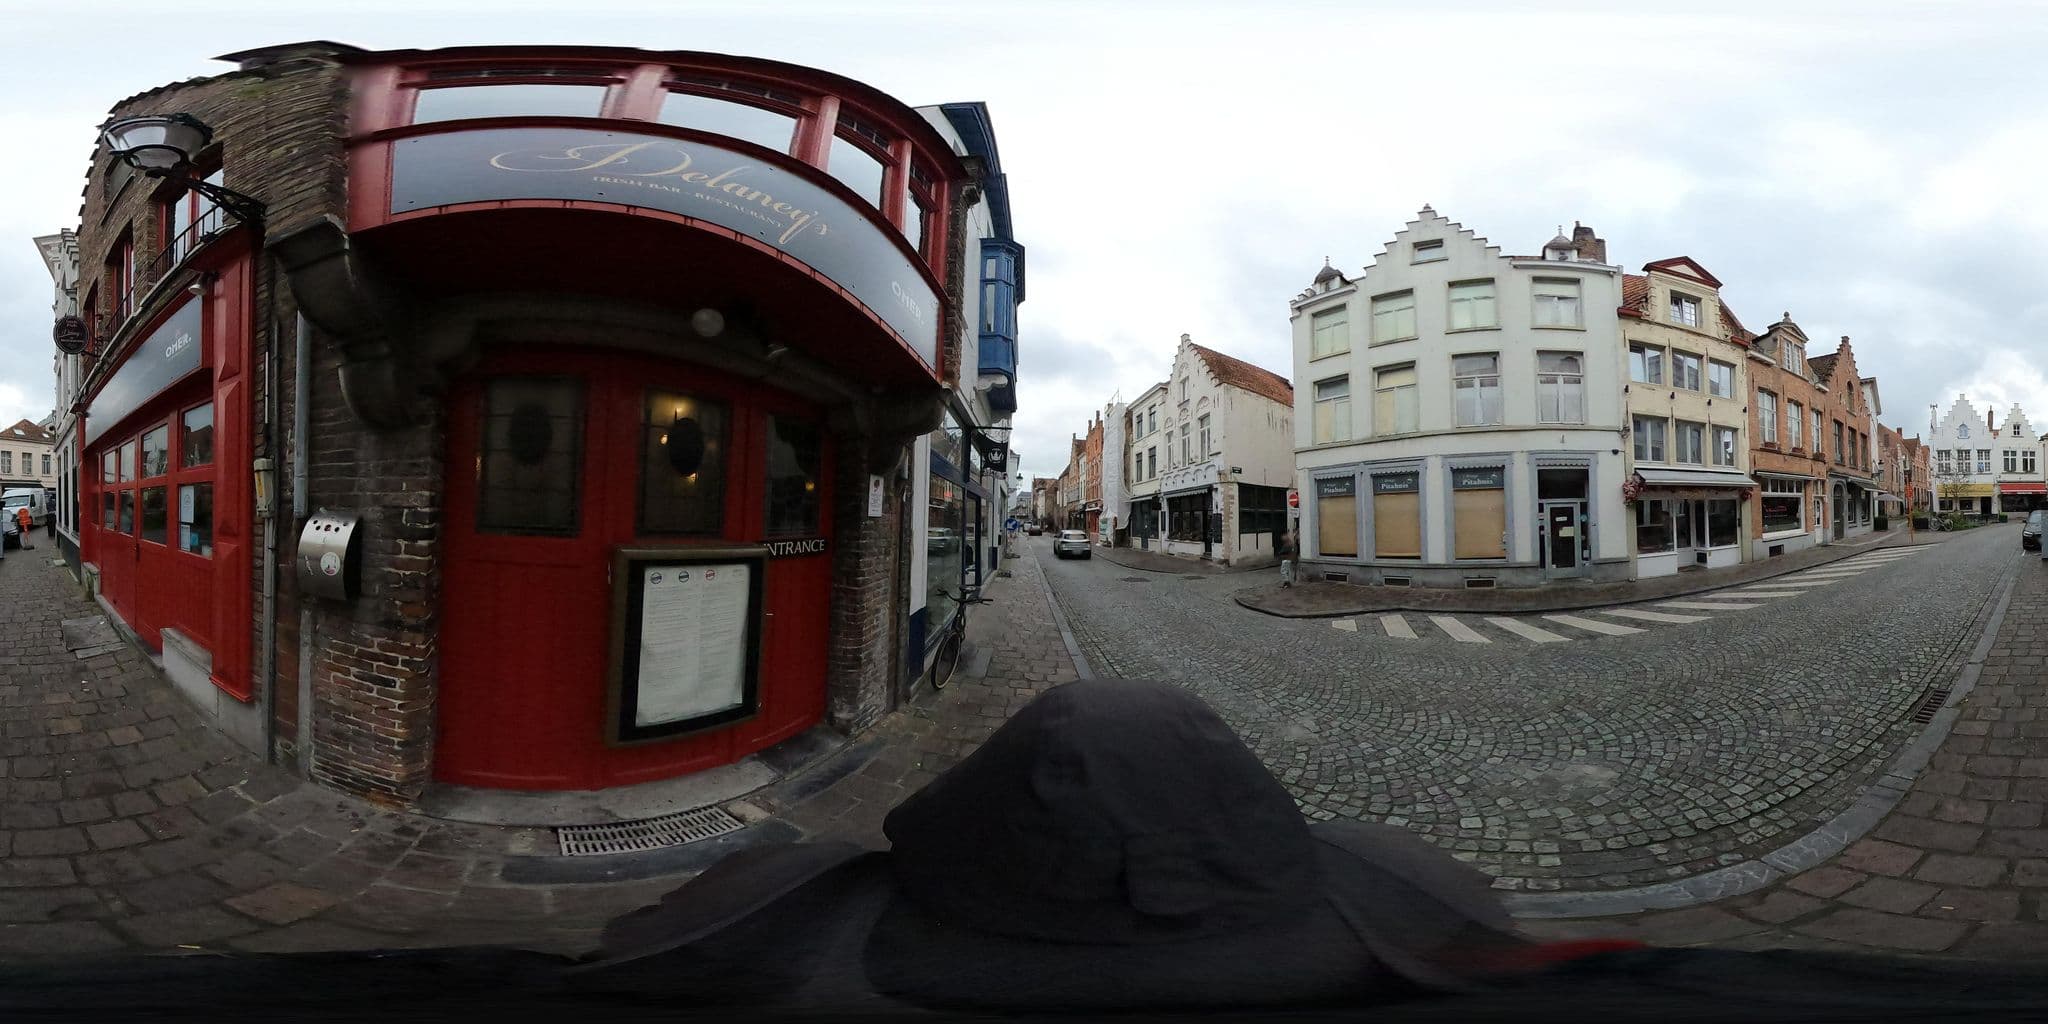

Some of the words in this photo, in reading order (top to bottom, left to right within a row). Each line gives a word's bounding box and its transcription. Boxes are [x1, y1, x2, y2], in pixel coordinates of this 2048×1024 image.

[490, 141, 827, 244] Delaney's
[593, 176, 642, 187] IRISH
[649, 182, 681, 194] BAR
[695, 191, 784, 229] RESTAURANT
[764, 539, 825, 556] NTRANCE
